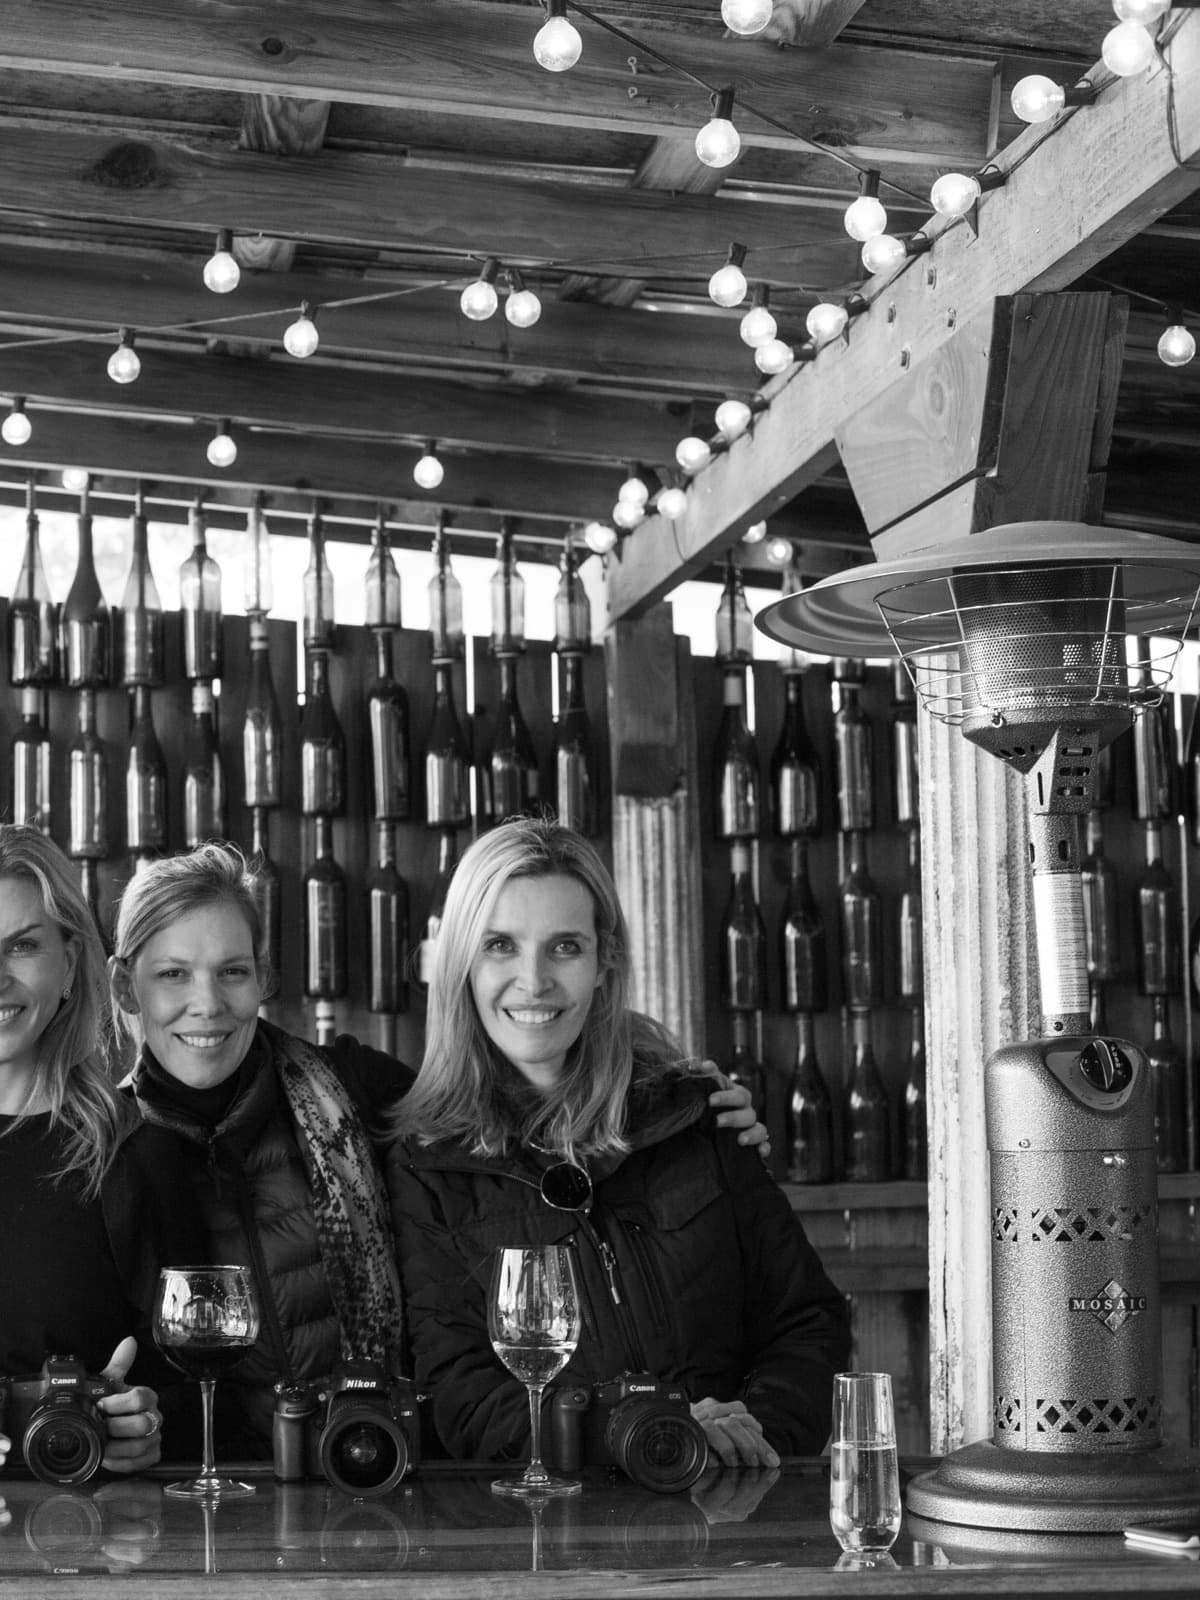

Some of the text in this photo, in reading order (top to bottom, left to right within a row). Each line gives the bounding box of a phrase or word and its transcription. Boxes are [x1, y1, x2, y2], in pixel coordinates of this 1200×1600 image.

[1073, 1299, 1145, 1310] MOSAIC
[51, 1377, 77, 1385] Canon
[346, 1379, 376, 1388] Nikon
[629, 1384, 656, 1392] Canon
